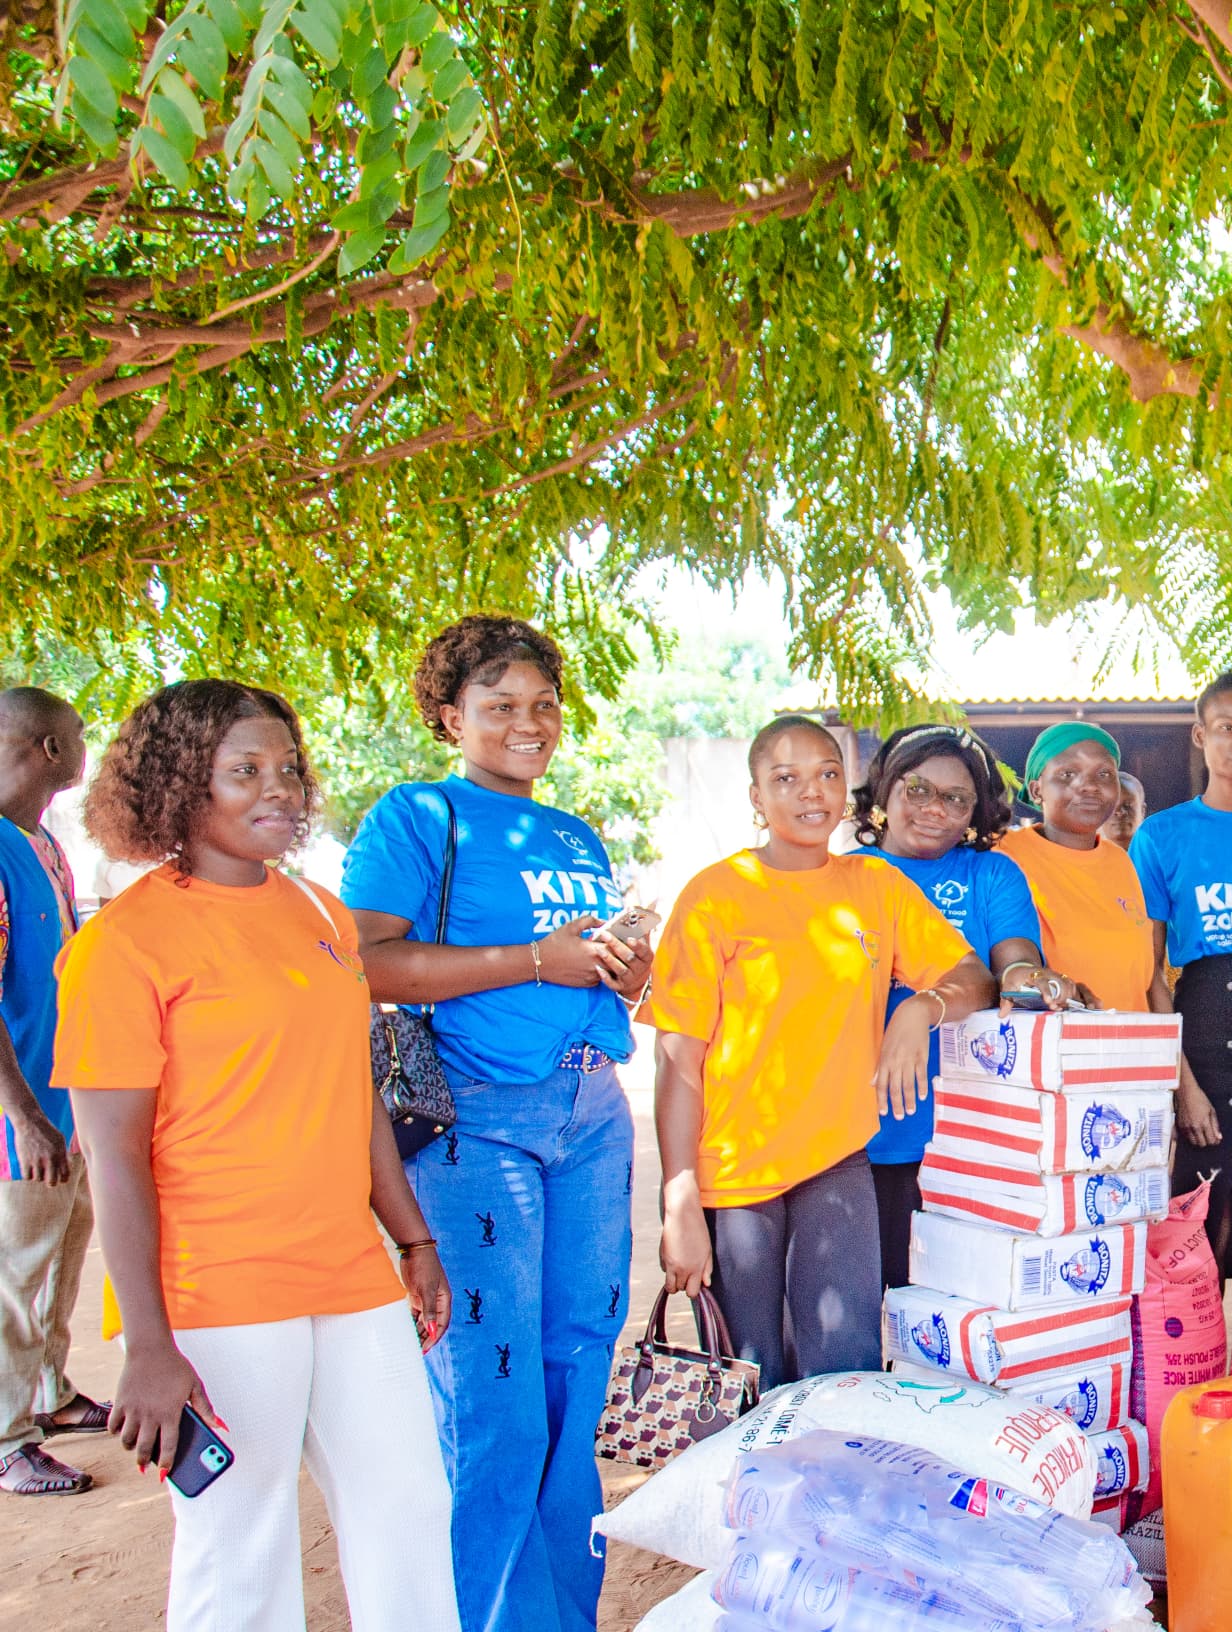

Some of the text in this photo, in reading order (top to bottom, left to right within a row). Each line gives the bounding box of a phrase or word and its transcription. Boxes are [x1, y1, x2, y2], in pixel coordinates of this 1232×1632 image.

[520, 869, 625, 909] KITS
[1003, 1027, 1017, 1072] BONITA
[1081, 1111, 1096, 1155] BONITA
[1085, 1179, 1098, 1223] BONITA
[1095, 1242, 1109, 1286] BONITA
[1168, 1249, 1186, 1269] OF
[937, 1319, 949, 1362] BONITA
[1164, 1352, 1182, 1366] 25%
[1183, 1350, 1208, 1365] POLISH
[1163, 1370, 1186, 1386] RICE
[1187, 1367, 1211, 1385] WHITE
[1084, 1382, 1098, 1425] BONITA
[1111, 1448, 1126, 1490] BONITA
